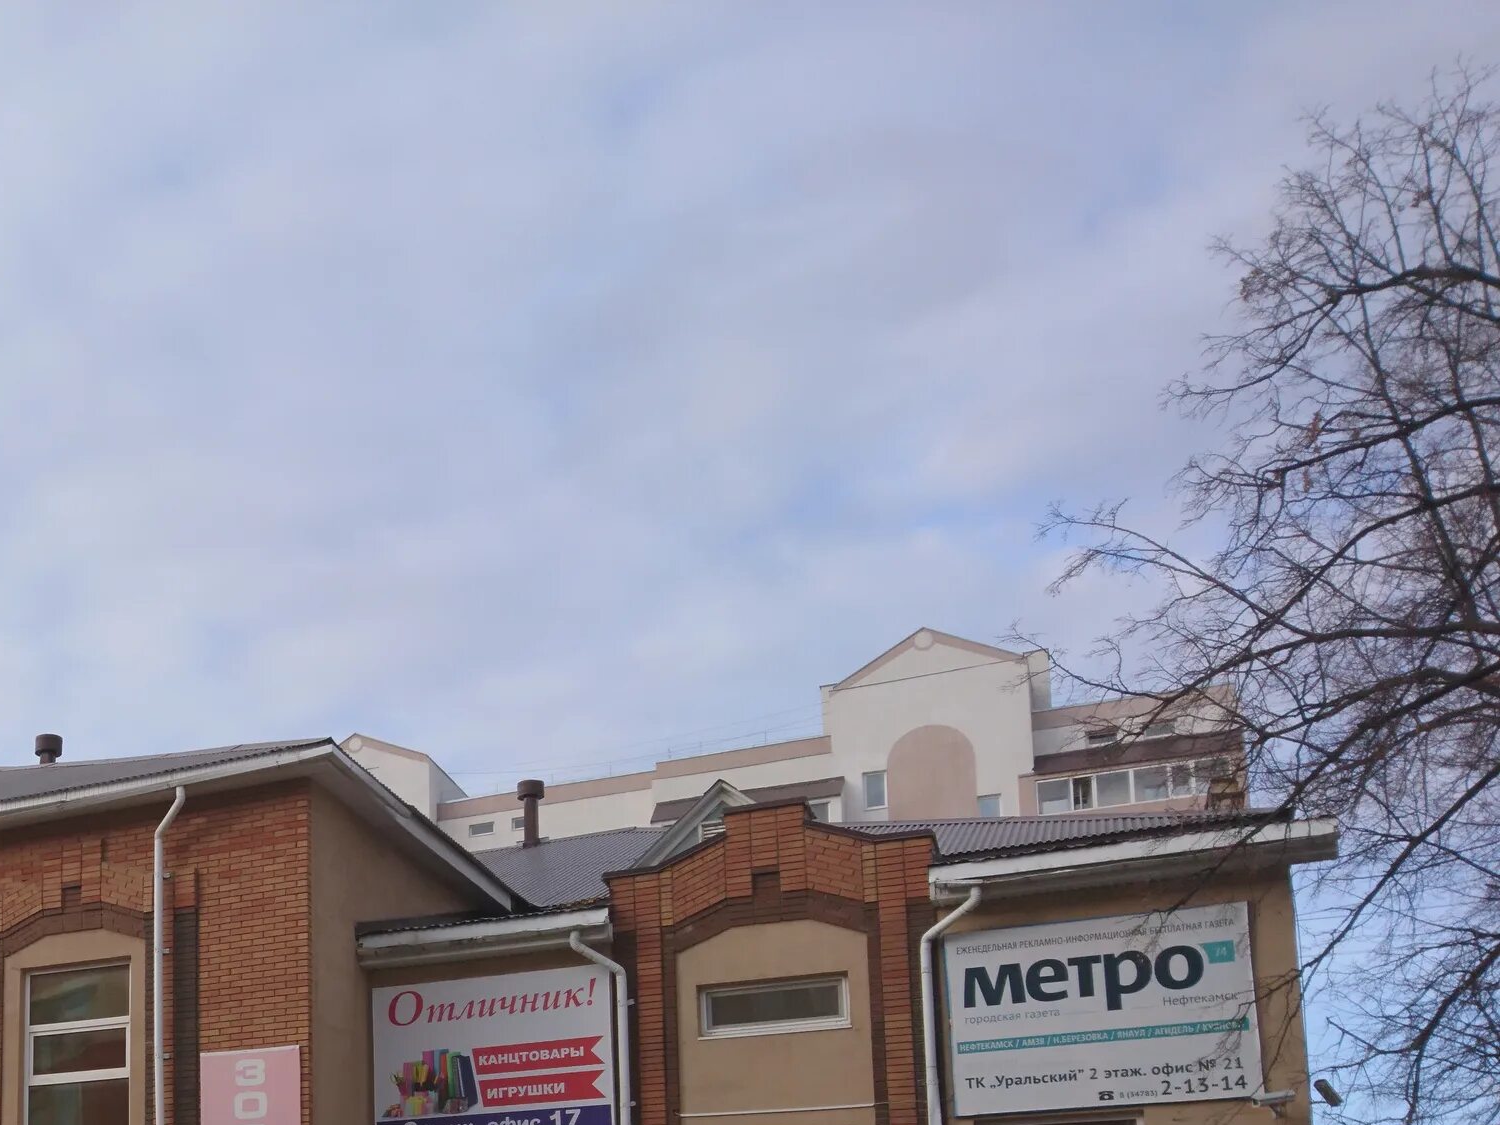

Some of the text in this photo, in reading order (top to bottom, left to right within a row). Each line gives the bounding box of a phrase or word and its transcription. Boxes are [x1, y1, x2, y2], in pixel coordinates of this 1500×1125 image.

[956, 940, 1018, 956] ЕЖЕНЕДЕЛЬНАЯ
[1204, 917, 1235, 929] ГАЗЕТА
[963, 944, 1204, 1011] метро
[388, 977, 596, 1027] Отличник!
[1162, 991, 1240, 1008] Нефтекамск
[964, 1008, 1061, 1025] городская газета
[959, 1040, 1013, 1053] НЕФТЕКАМСК
[1117, 1028, 1145, 1039] ЯНАУЛ
[1155, 1023, 1194, 1037] АГИДЕЛЬ
[478, 1046, 584, 1066] КАНЦТОВАРЫ
[965, 1076, 986, 1090] ТК
[1089, 1068, 1098, 1081] 2
[1151, 1060, 1194, 1077] офис
[1223, 1056, 1244, 1070] 21
[1161, 1074, 1248, 1097] 2-13-14
[486, 1082, 565, 1100] ИГРУШКИ
